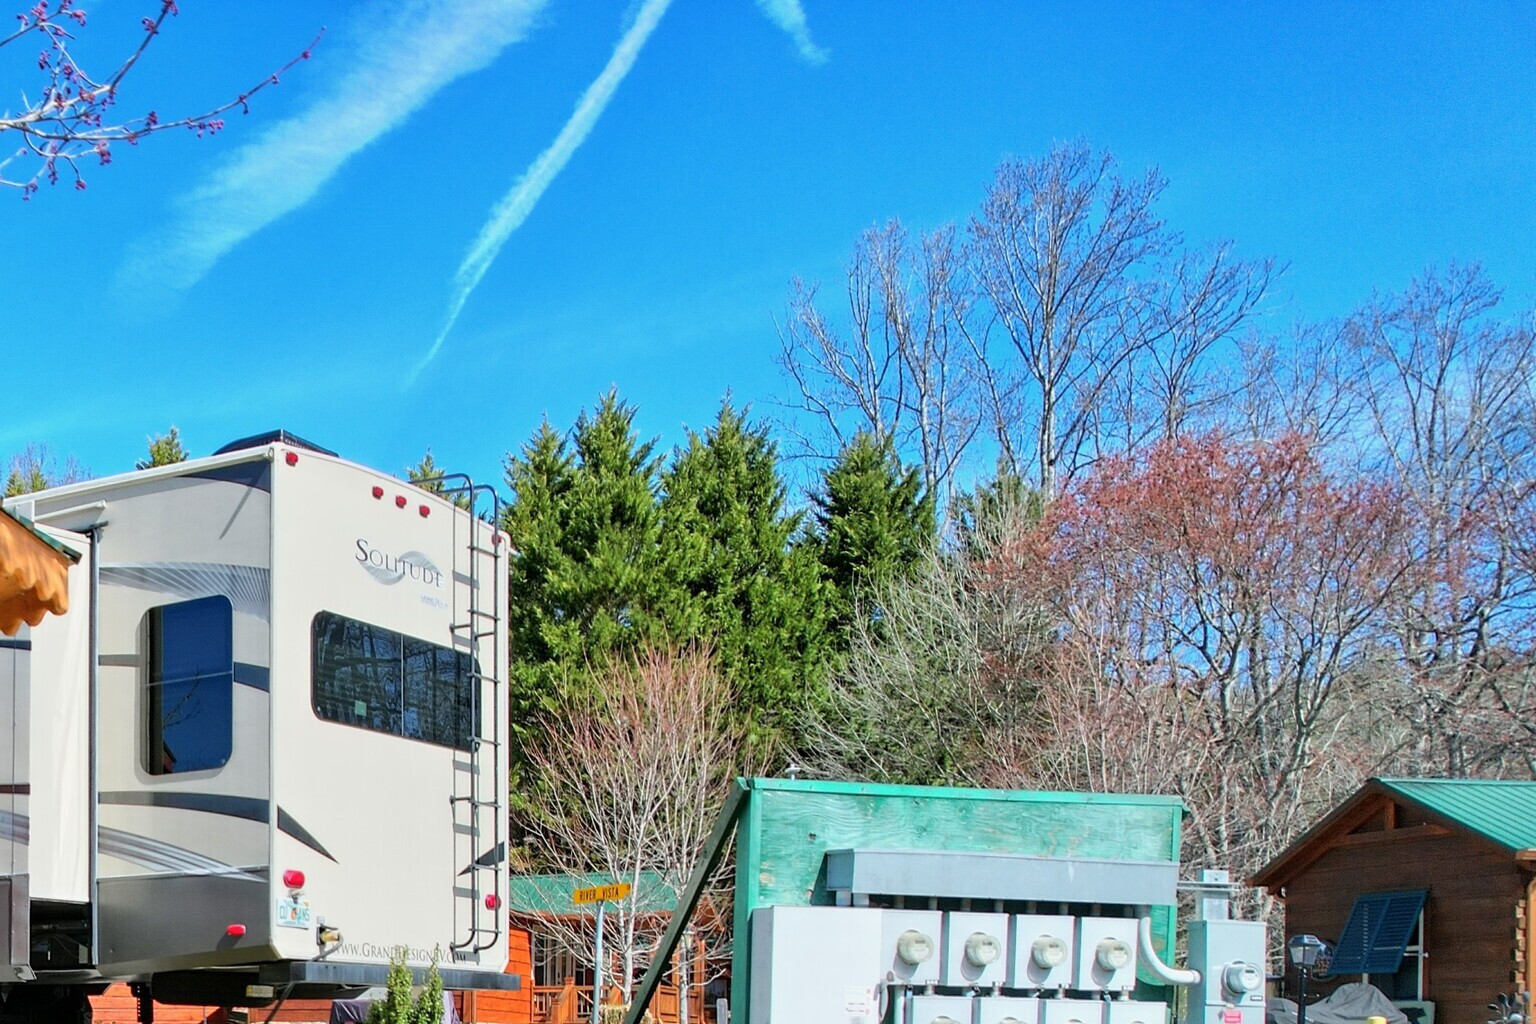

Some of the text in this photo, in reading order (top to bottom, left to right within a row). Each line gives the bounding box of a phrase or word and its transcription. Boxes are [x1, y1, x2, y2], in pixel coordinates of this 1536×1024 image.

[355, 538, 445, 588] SOLITUDE
[579, 889, 596, 901] RIVER
[602, 886, 619, 899] VISTA
